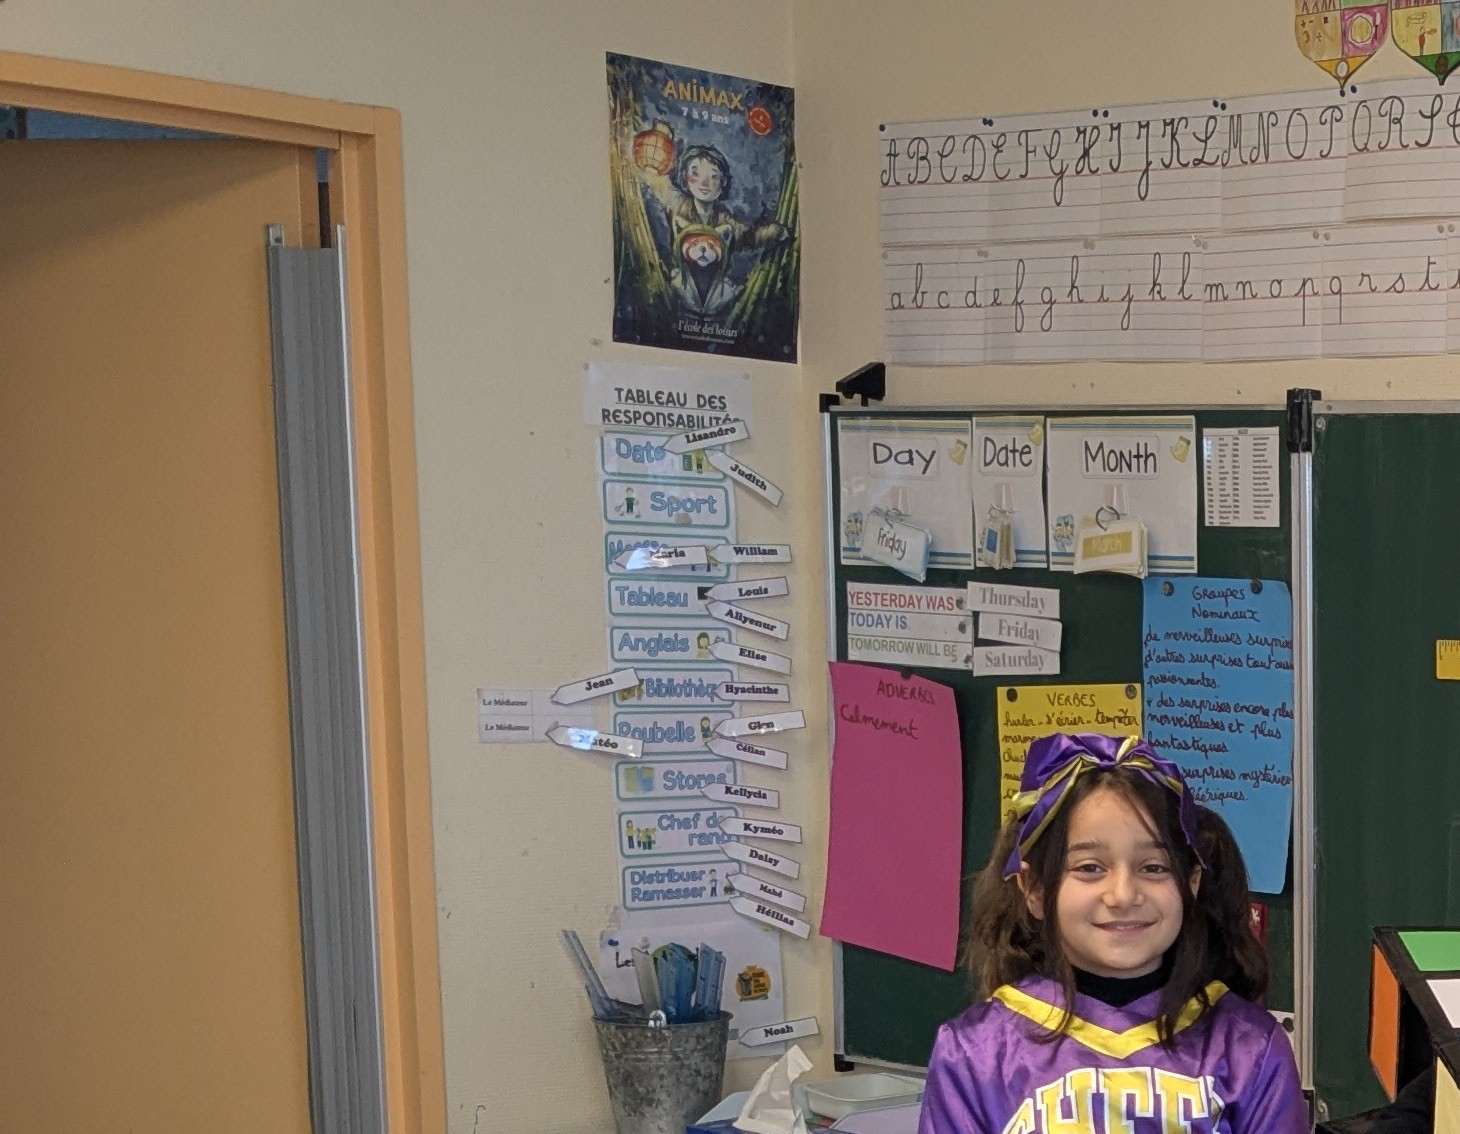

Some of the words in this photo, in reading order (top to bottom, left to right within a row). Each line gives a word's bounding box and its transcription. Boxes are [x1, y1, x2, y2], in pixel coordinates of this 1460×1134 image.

[615, 388, 687, 407] TABLEAU
[697, 394, 727, 410] DES
[601, 408, 740, 429] RESPONSABILIT
[685, 427, 736, 443] Lisandro
[615, 438, 666, 463] Date
[873, 442, 936, 474] Day
[983, 437, 1033, 467] Date
[1084, 441, 1158, 473] Month
[730, 463, 768, 491] Judith
[651, 492, 717, 517] Sport
[733, 546, 778, 556] William
[878, 527, 906, 560] Friday
[616, 586, 688, 608] Tableau
[738, 585, 769, 598] Louis
[849, 591, 923, 609] YESTERDAY
[925, 596, 954, 611] WAS
[981, 587, 1045, 614] Thursday
[850, 612, 892, 628] TODAY
[895, 616, 908, 629] IS
[999, 619, 1040, 645] Friday
[618, 633, 690, 656] Anglais
[850, 637, 914, 654] TOMORROW
[916, 642, 940, 656] WILL
[739, 648, 767, 662] Elise
[985, 651, 1045, 671] Saturday
[585, 677, 613, 691] Jean
[725, 685, 779, 696] Hyacinthe
[1047, 693, 1095, 707] VERBES
[619, 722, 695, 742] Poubelle
[840, 705, 919, 740] Calmement
[658, 814, 700, 831] Chef
[743, 824, 784, 837] Kyméo
[749, 850, 779, 867] Daisy
[631, 869, 705, 885] Distribuer
[631, 887, 706, 901] Ramasser
[760, 883, 782, 898] Mahé
[764, 1024, 794, 1038] Noah
